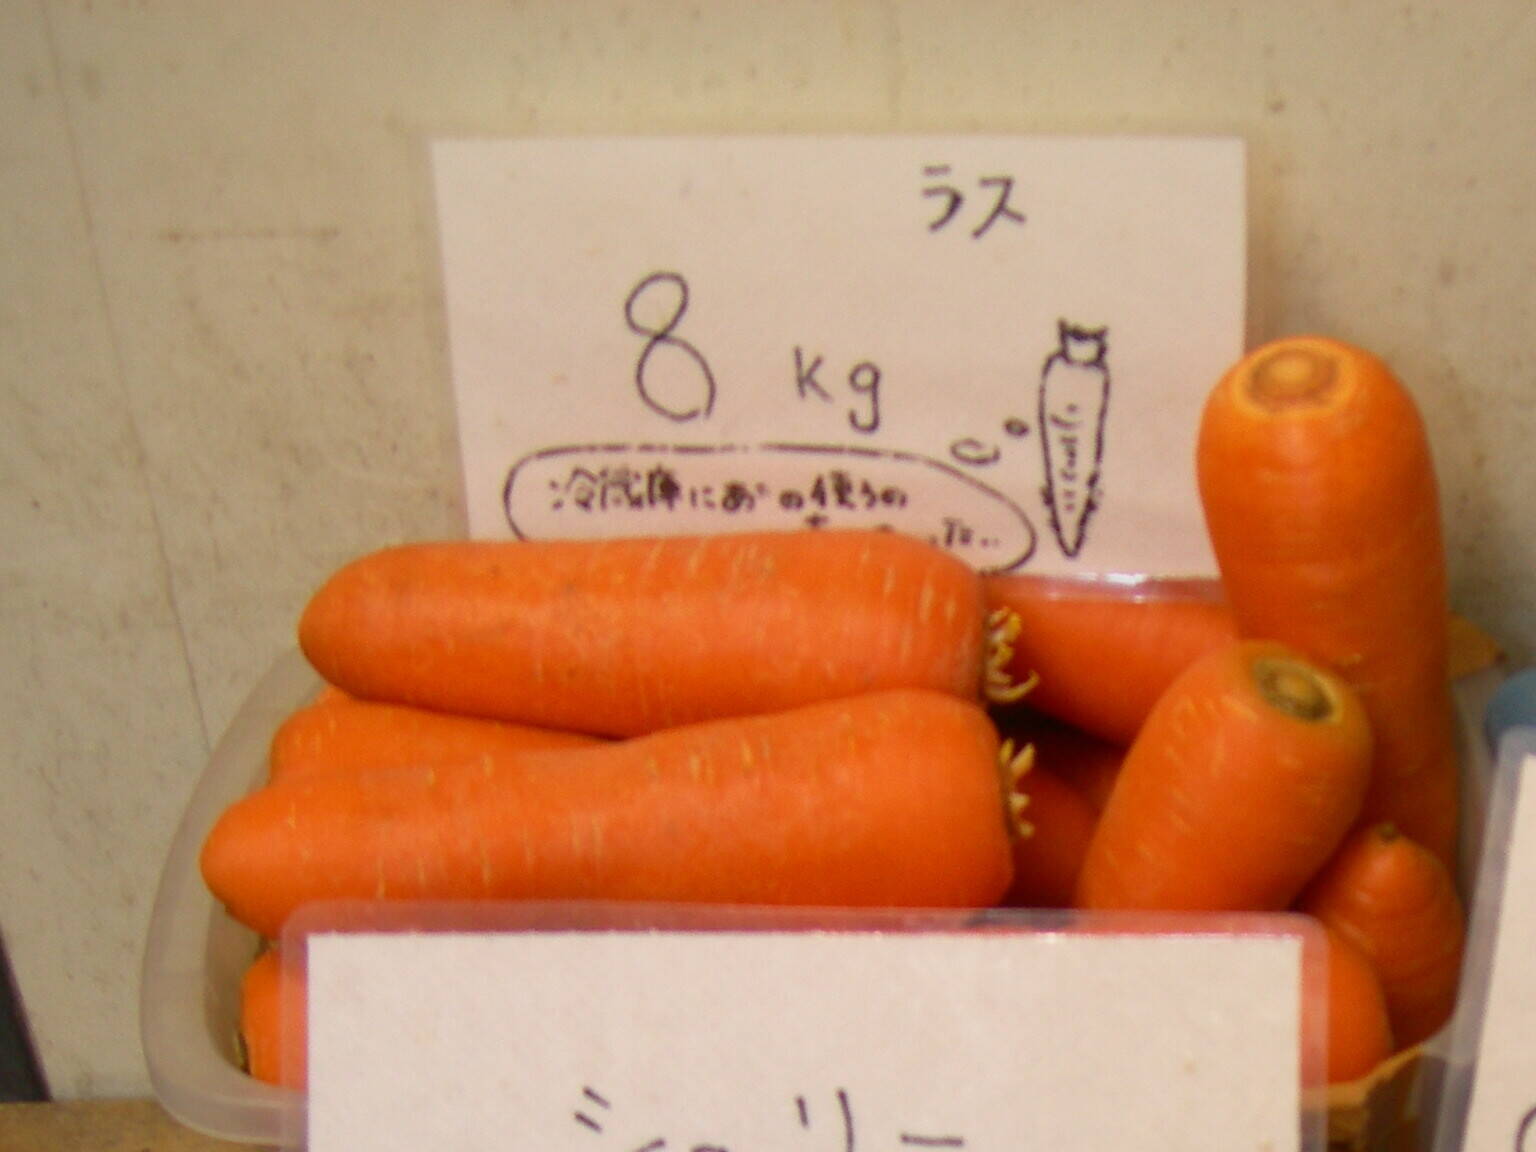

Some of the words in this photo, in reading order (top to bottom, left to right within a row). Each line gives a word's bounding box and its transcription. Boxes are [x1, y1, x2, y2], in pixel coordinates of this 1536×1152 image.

[922, 165, 1027, 240] ラス
[623, 270, 719, 424] 8
[793, 346, 883, 435] kg
